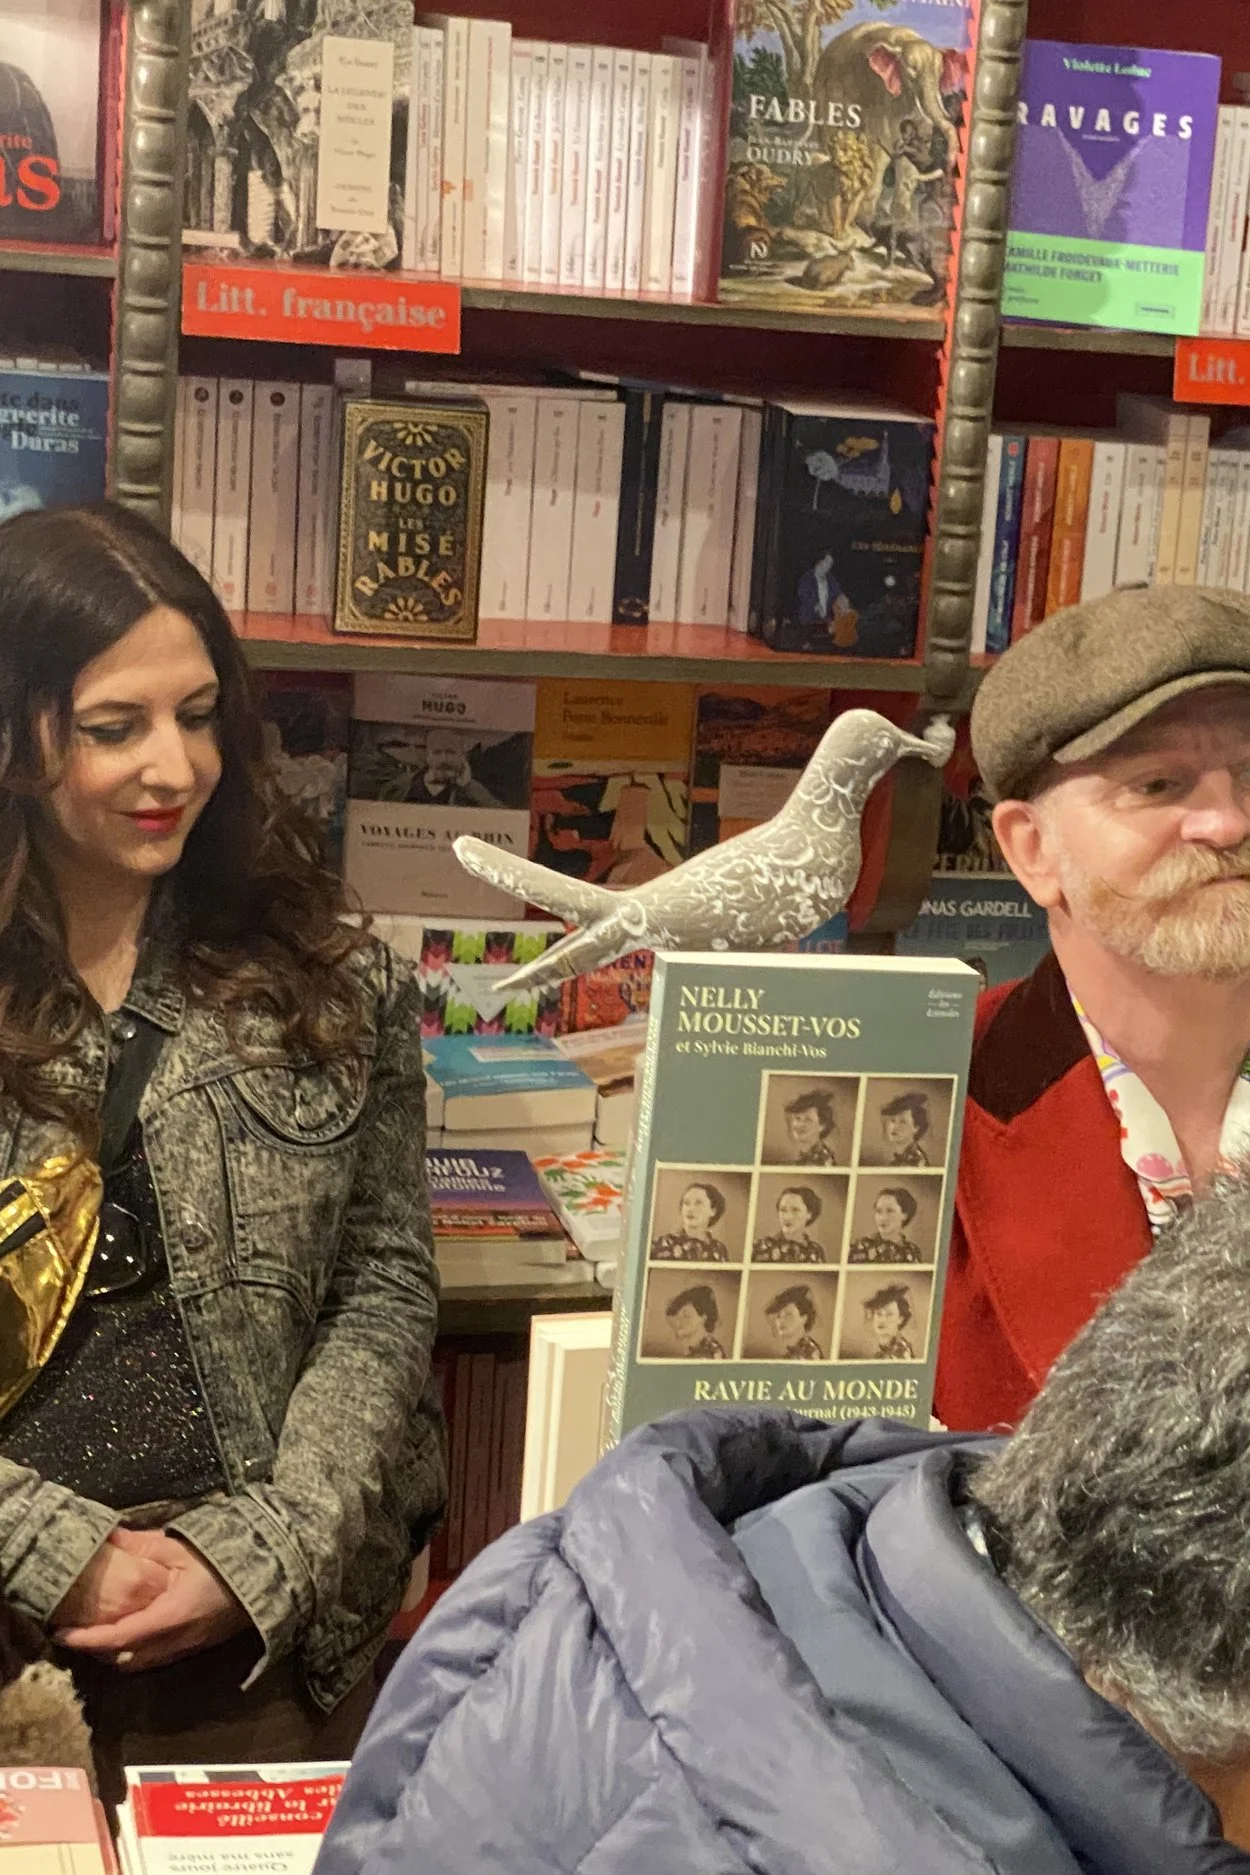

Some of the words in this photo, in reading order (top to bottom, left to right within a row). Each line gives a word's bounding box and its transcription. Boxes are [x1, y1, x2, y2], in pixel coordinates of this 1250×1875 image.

[750, 94, 862, 128] FABLES
[1017, 101, 1193, 140] RAVAGES
[196, 280, 267, 317] Litt.
[282, 287, 447, 333] française
[1188, 352, 1246, 385] Litt.
[11, 430, 79, 454] Duras
[362, 439, 467, 480] VICTOR
[369, 480, 457, 507] HUGO
[367, 530, 455, 555] MISÉ
[353, 556, 463, 607] RABLES
[421, 699, 467, 715] HUGO
[360, 823, 437, 840] VOYAGES
[918, 900, 957, 917] NAS
[959, 900, 1032, 918] GARDELL
[680, 985, 765, 1010] NELLY
[677, 1010, 862, 1040] MOUSSET-VOS
[676, 1041, 691, 1053] et
[694, 1040, 739, 1057] Sylvie
[743, 1042, 827, 1059] Bianchi-Vos
[693, 1379, 772, 1401] RAVIE
[777, 1379, 816, 1402] AU
[823, 1378, 919, 1401] MONDE
[792, 1405, 837, 1419] urnal
[840, 1403, 916, 1420] (1943-1945)
[0, 1770, 64, 1792] FO
[185, 1787, 294, 1800] Abbesses
[174, 1800, 272, 1814] librairie
[284, 1799, 306, 1812] la
[216, 1811, 323, 1828] conseillé
[168, 1852, 215, 1862] mère
[220, 1851, 250, 1860] ma
[254, 1850, 295, 1859] sans
[169, 1861, 216, 1873] jours
[222, 1860, 289, 1873] Quatre
